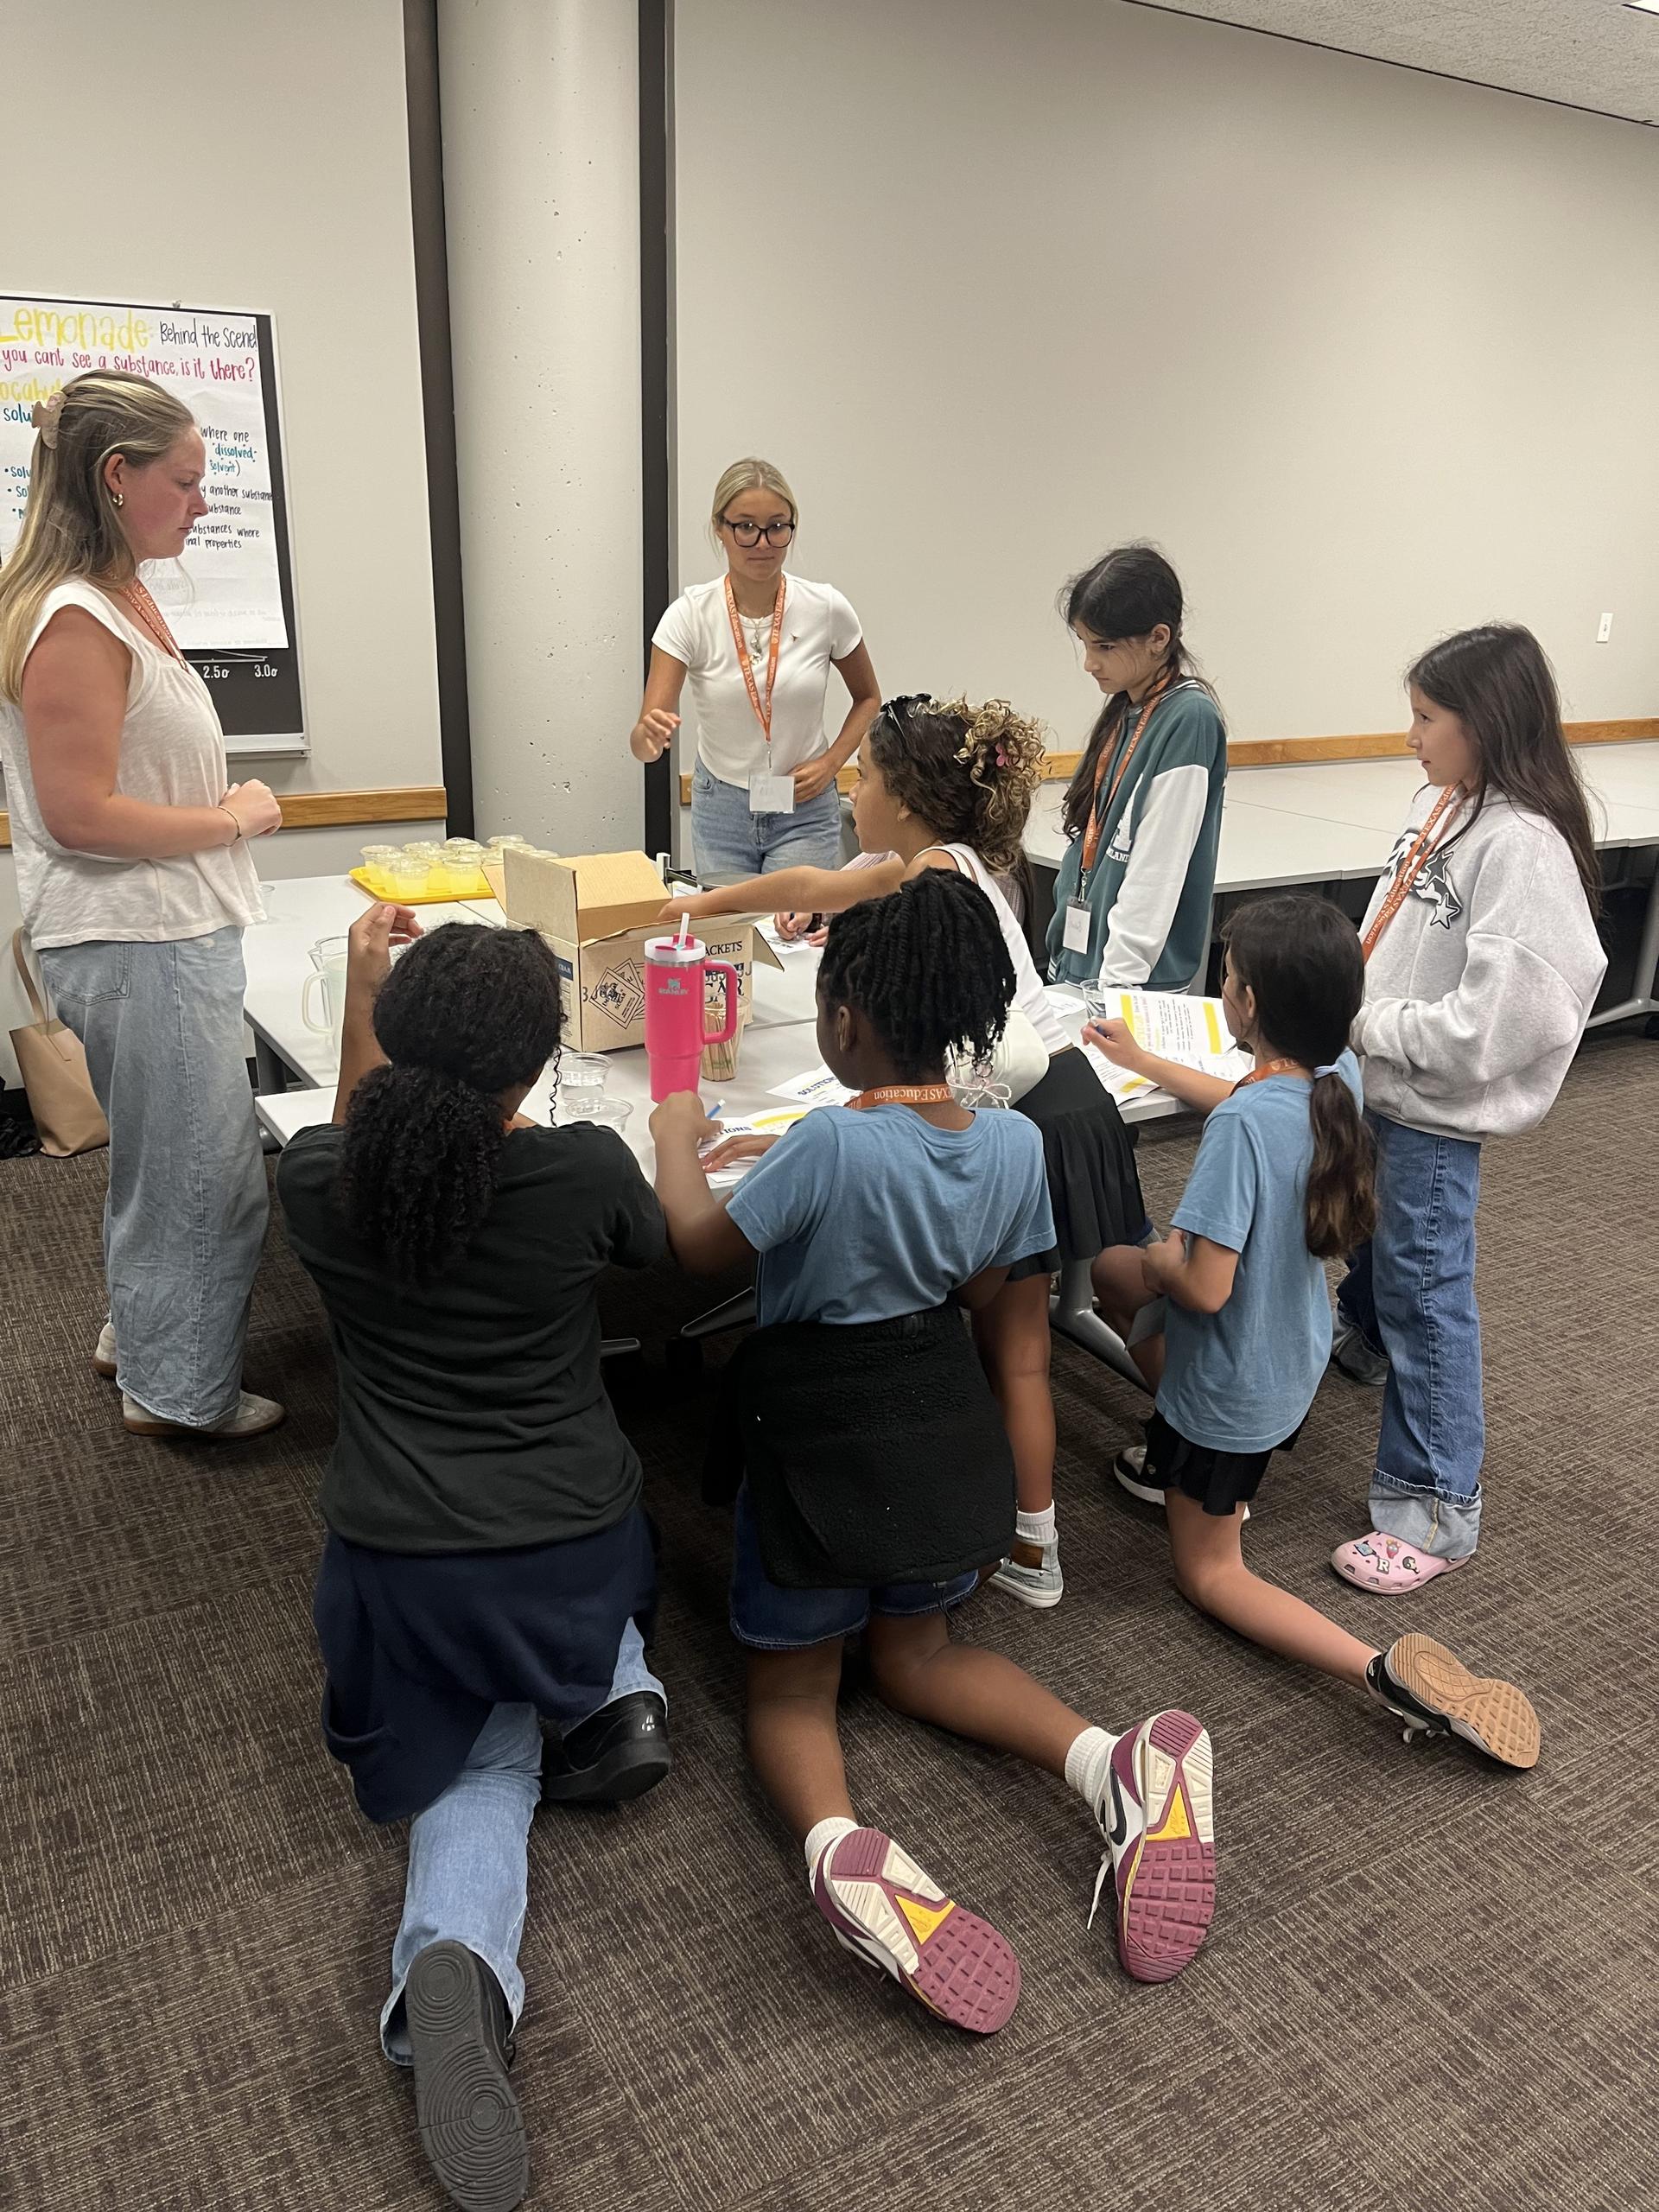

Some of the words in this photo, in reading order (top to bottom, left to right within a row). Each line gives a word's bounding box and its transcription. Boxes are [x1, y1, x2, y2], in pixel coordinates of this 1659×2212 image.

[160, 318, 199, 347] Behind
[201, 325, 220, 348] the
[3, 348, 28, 372] you
[73, 352, 92, 369] see
[99, 355, 106, 369] a
[114, 354, 179, 378] substance,
[180, 358, 190, 376] is
[194, 358, 205, 379] it
[210, 357, 255, 382] there?
[200, 426, 228, 441] where
[233, 431, 249, 442] one
[210, 485, 238, 498] another
[237, 528, 260, 537] where
[205, 539, 242, 550] properties
[1420, 804, 1443, 836] TEXAS
[874, 1088, 928, 1101] Education
[719, 1126, 752, 1135] IONS
[1378, 1559, 1389, 1573] R
